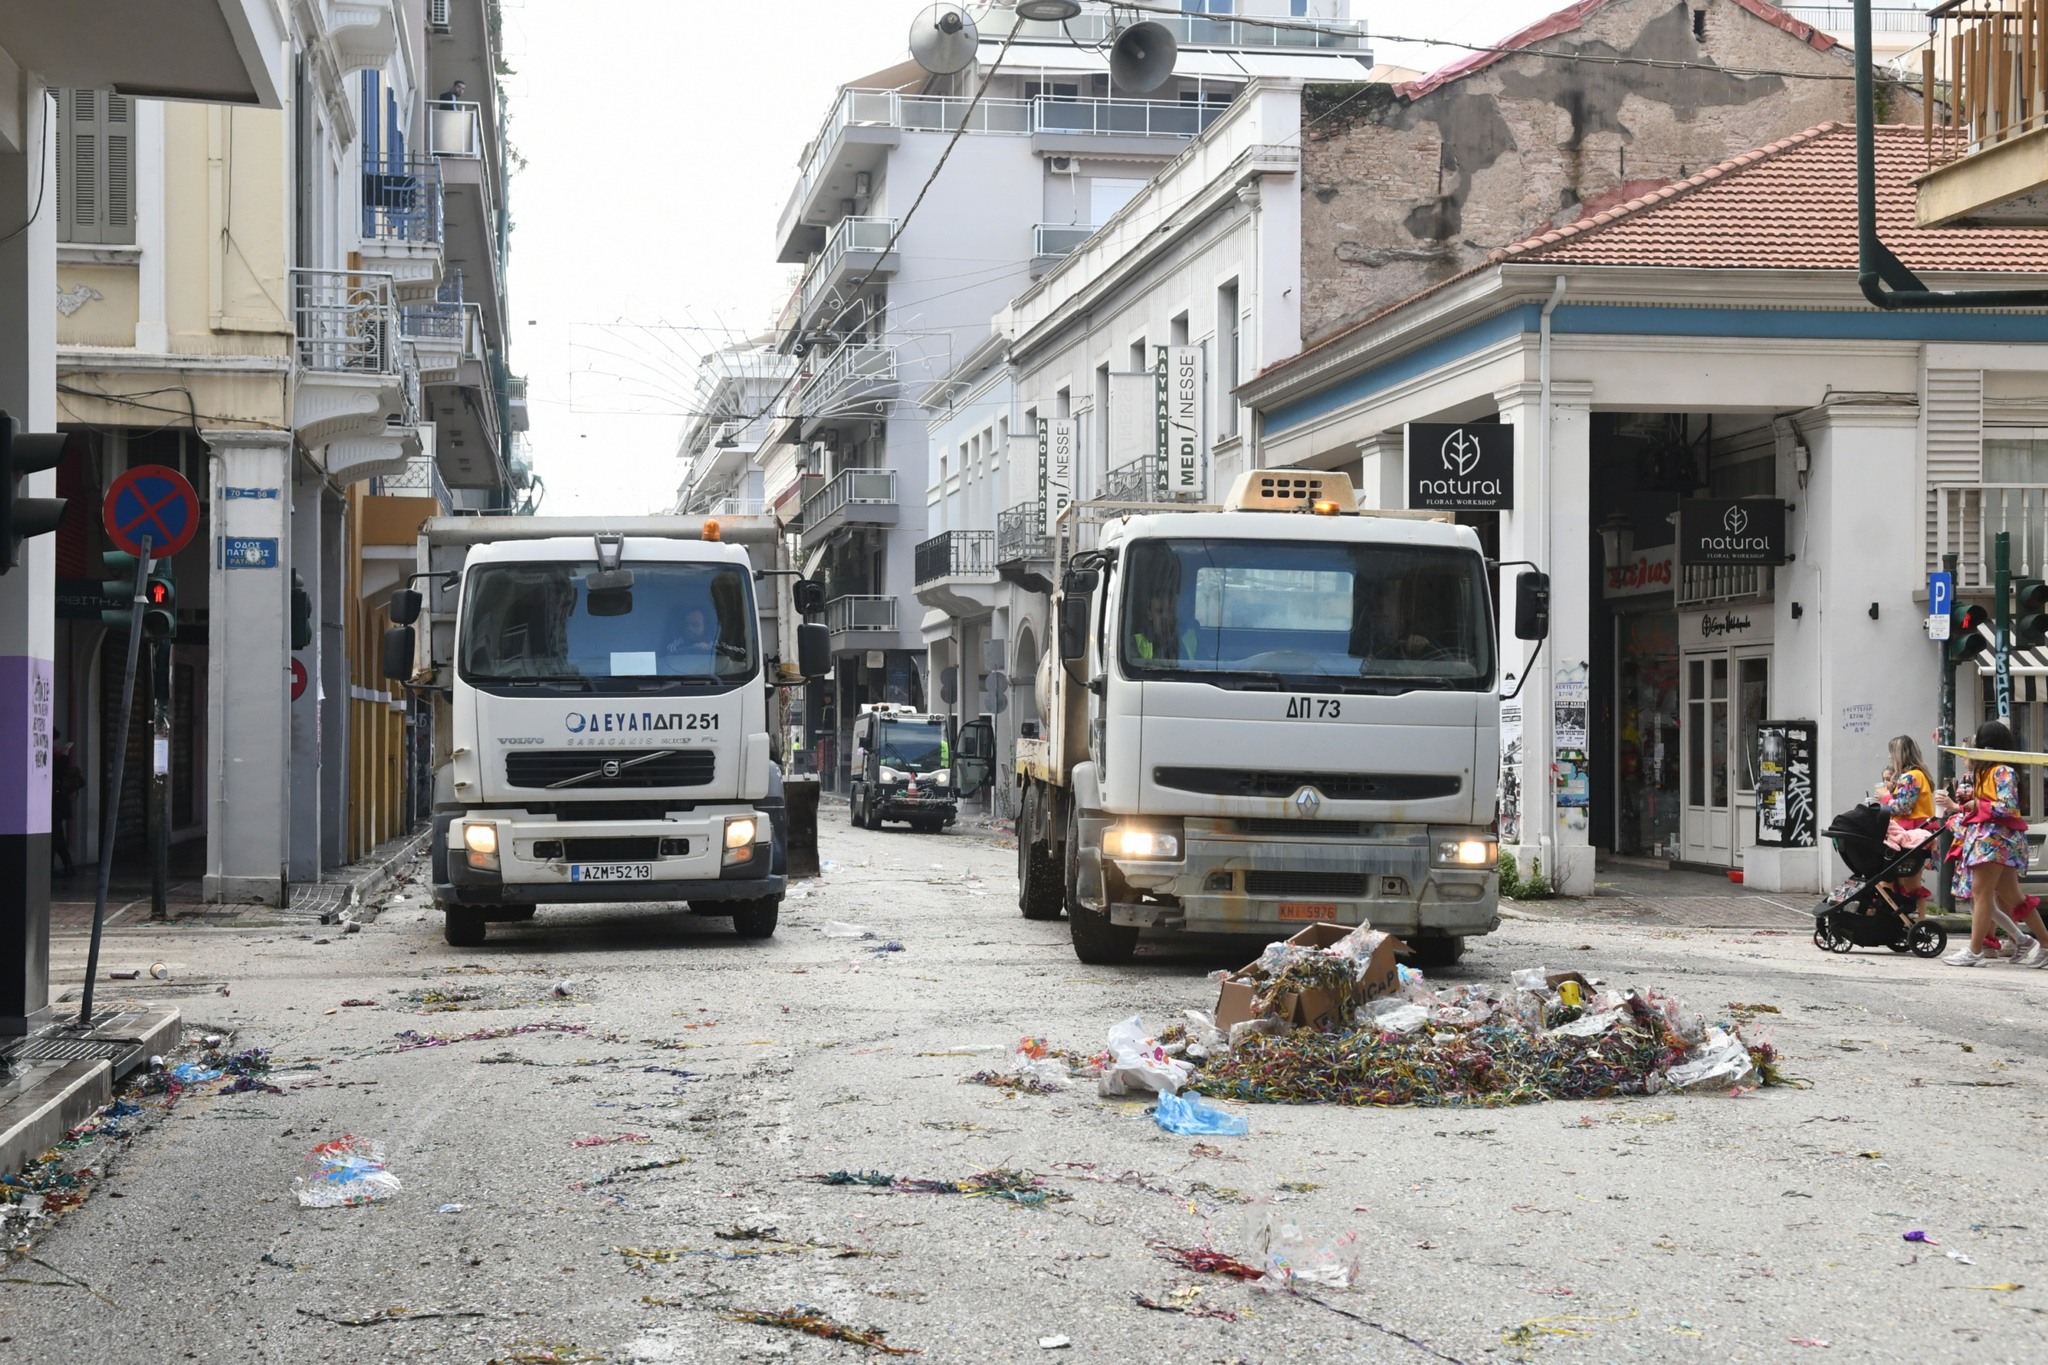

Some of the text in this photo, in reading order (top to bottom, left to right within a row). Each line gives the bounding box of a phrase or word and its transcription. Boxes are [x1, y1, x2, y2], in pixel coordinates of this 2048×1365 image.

[1158, 349, 1168, 485] ΑΔΥΝΑΤΙΣΜΑ
[1039, 422, 1047, 532] ΑΠΟΤΡΙΧΩΣΗ
[1419, 478, 1502, 495] natural
[234, 541, 261, 549] ΟΔΟΣ
[1701, 536, 1770, 550] natural
[1935, 582, 1945, 614] P
[1286, 696, 1341, 719] ΔΠ 73
[589, 713, 652, 731] ΔΕΥΑΠ
[497, 737, 545, 745] VOLVO
